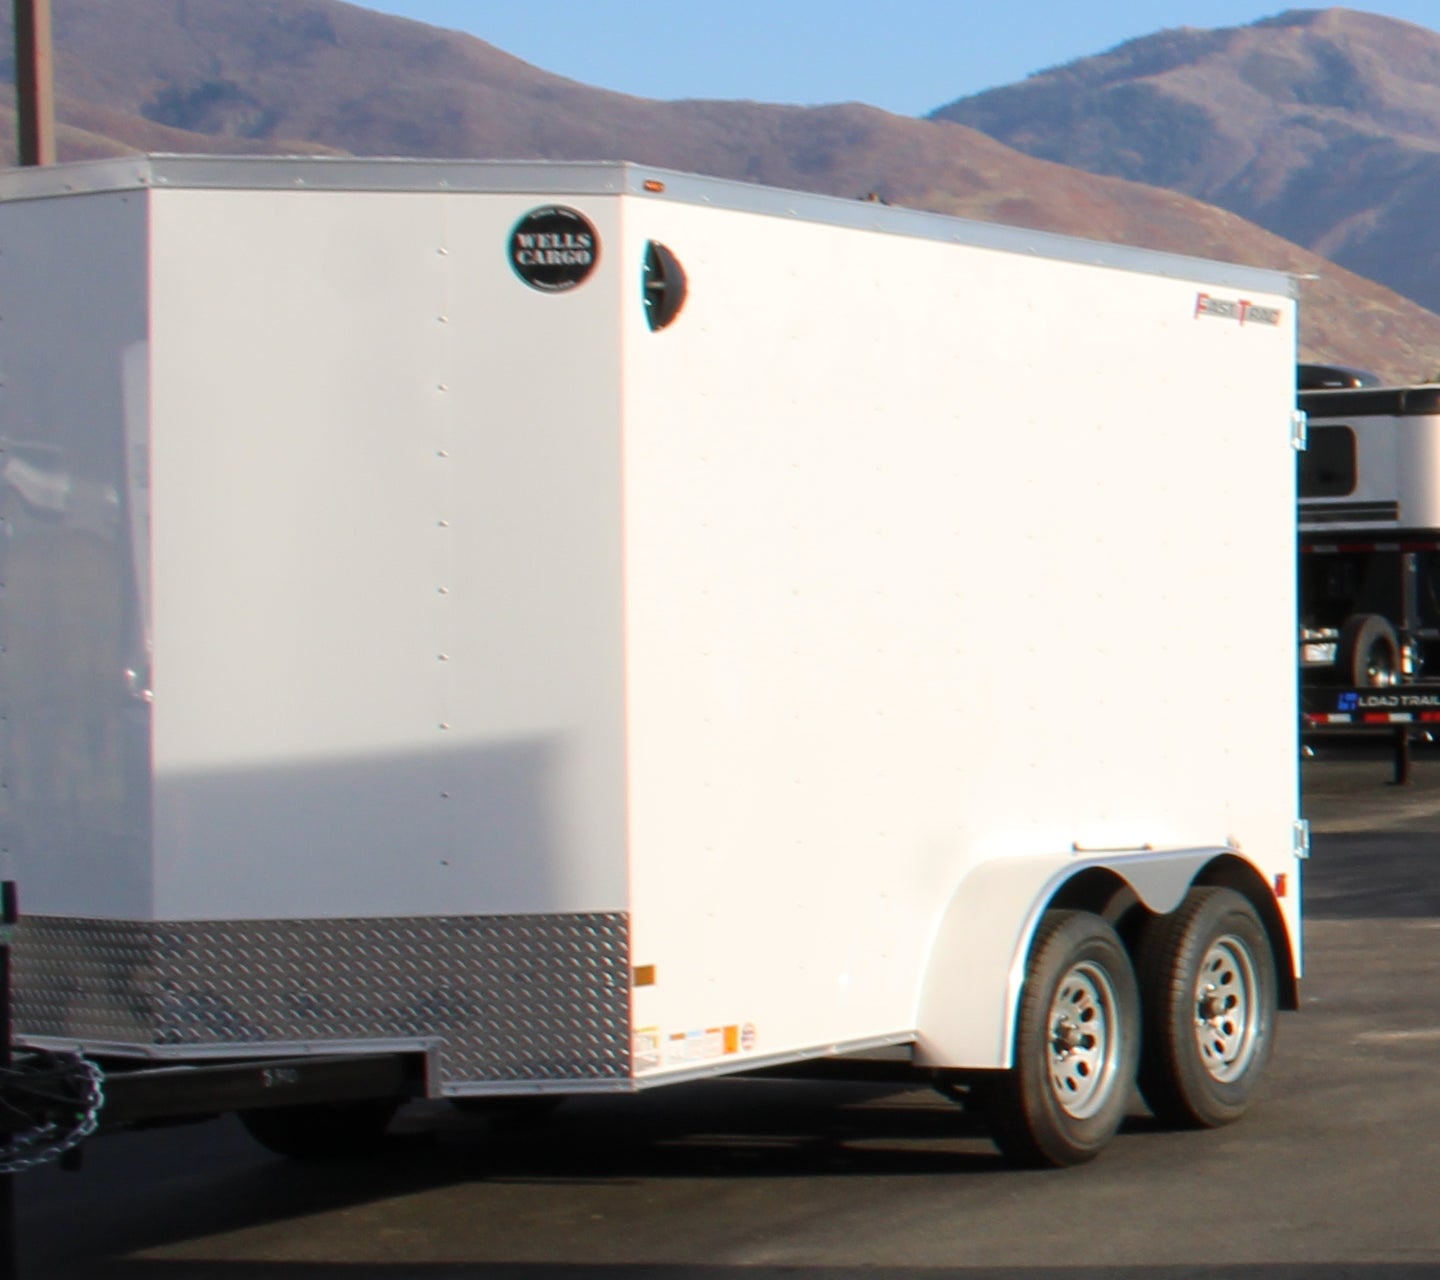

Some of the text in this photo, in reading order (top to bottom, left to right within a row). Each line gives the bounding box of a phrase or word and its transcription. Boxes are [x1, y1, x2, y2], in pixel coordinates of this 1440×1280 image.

[515, 232, 592, 249] WELLS
[515, 249, 593, 265] CARGO
[1358, 695, 1398, 707] LOAD
